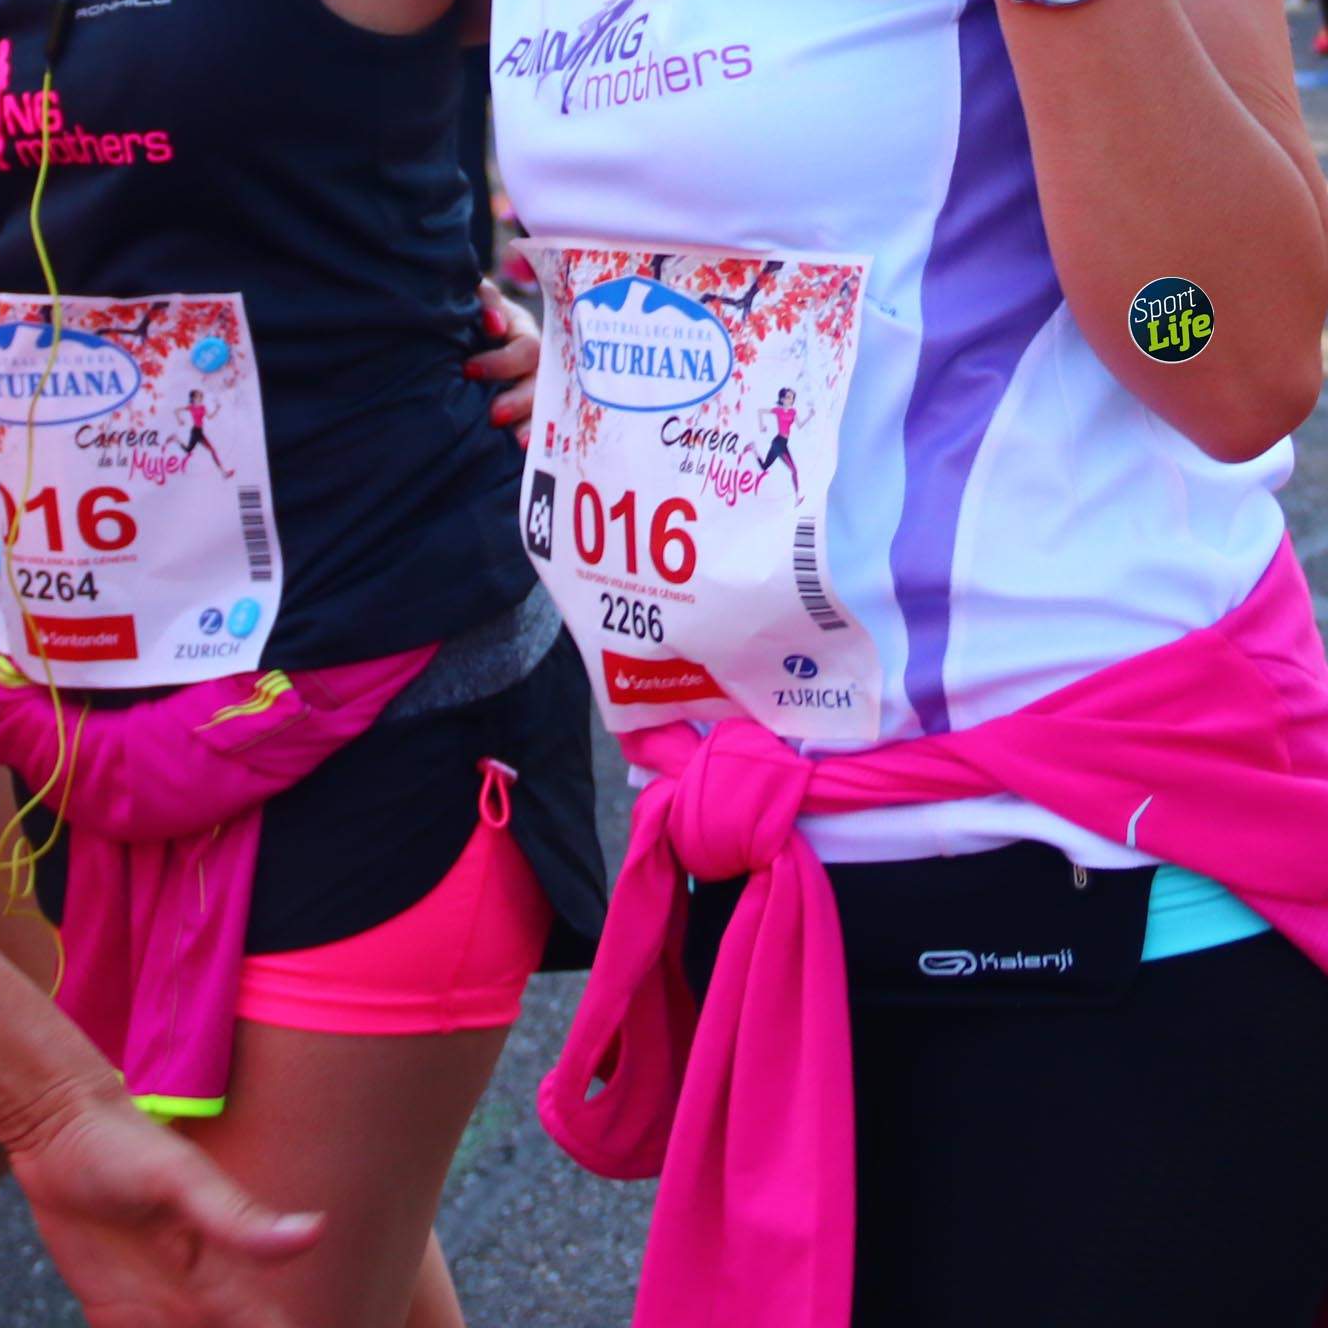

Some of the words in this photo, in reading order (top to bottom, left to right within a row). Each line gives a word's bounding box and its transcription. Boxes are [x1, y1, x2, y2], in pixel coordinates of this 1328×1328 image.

[583, 44, 753, 110] mothers
[15, 124, 173, 167] mothers
[586, 320, 641, 337] CENTRAL
[645, 325, 713, 341] LECHERA
[580, 339, 717, 383] STURIANA
[75, 424, 160, 449] Carrera
[660, 416, 740, 454] Carrera
[98, 448, 113, 468] de
[128, 446, 191, 486] Mujer
[679, 452, 694, 474] de
[696, 453, 706, 475] la
[700, 453, 769, 507] Mujer
[573, 480, 697, 586] 016
[17, 569, 99, 602] 2264
[600, 592, 664, 643] 2266
[174, 642, 240, 659] ZURICH
[772, 688, 851, 708] ZURICH
[980, 947, 1074, 973] Kalenji
